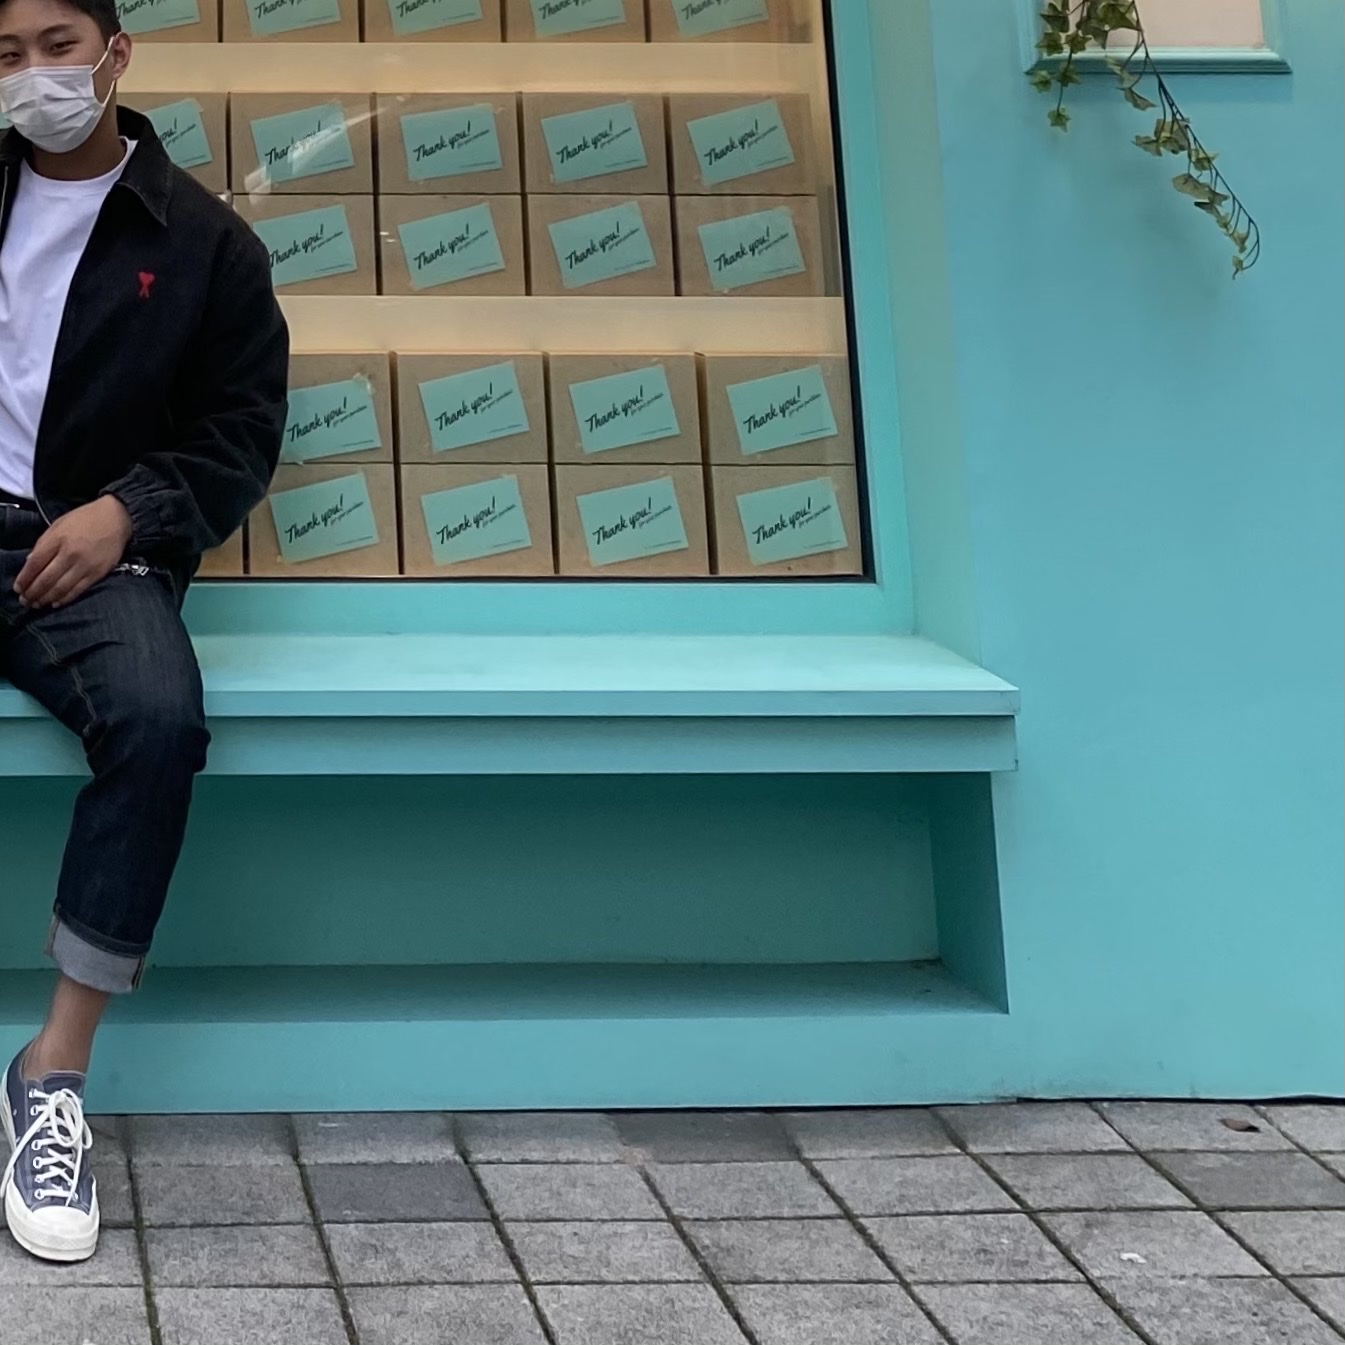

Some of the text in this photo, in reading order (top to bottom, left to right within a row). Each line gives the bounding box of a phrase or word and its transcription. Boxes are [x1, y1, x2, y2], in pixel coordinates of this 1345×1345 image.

[158, 117, 178, 144] ou!
[413, 135, 446, 161] Thank
[448, 121, 471, 150] you!
[557, 137, 591, 163] Thank
[592, 121, 613, 149] you!
[704, 136, 736, 164] Thank
[738, 119, 759, 149] you!
[301, 223, 323, 253] you!
[414, 242, 448, 270] Thank
[449, 224, 469, 254] you!
[565, 241, 599, 269] Thank
[600, 222, 620, 253] you!
[713, 243, 747, 271] Thank
[748, 226, 770, 256] you!
[286, 413, 323, 443] Thank
[323, 396, 347, 427] you!
[435, 382, 493, 431] Thank you!
[585, 402, 620, 432] Thank
[621, 385, 643, 416] you!
[743, 385, 800, 434] Thank you!
[284, 513, 321, 544] Thank
[321, 494, 343, 526] you!
[436, 496, 495, 544] Thank you!
[592, 496, 651, 545] Thank you!
[752, 496, 811, 544] Thank you!
